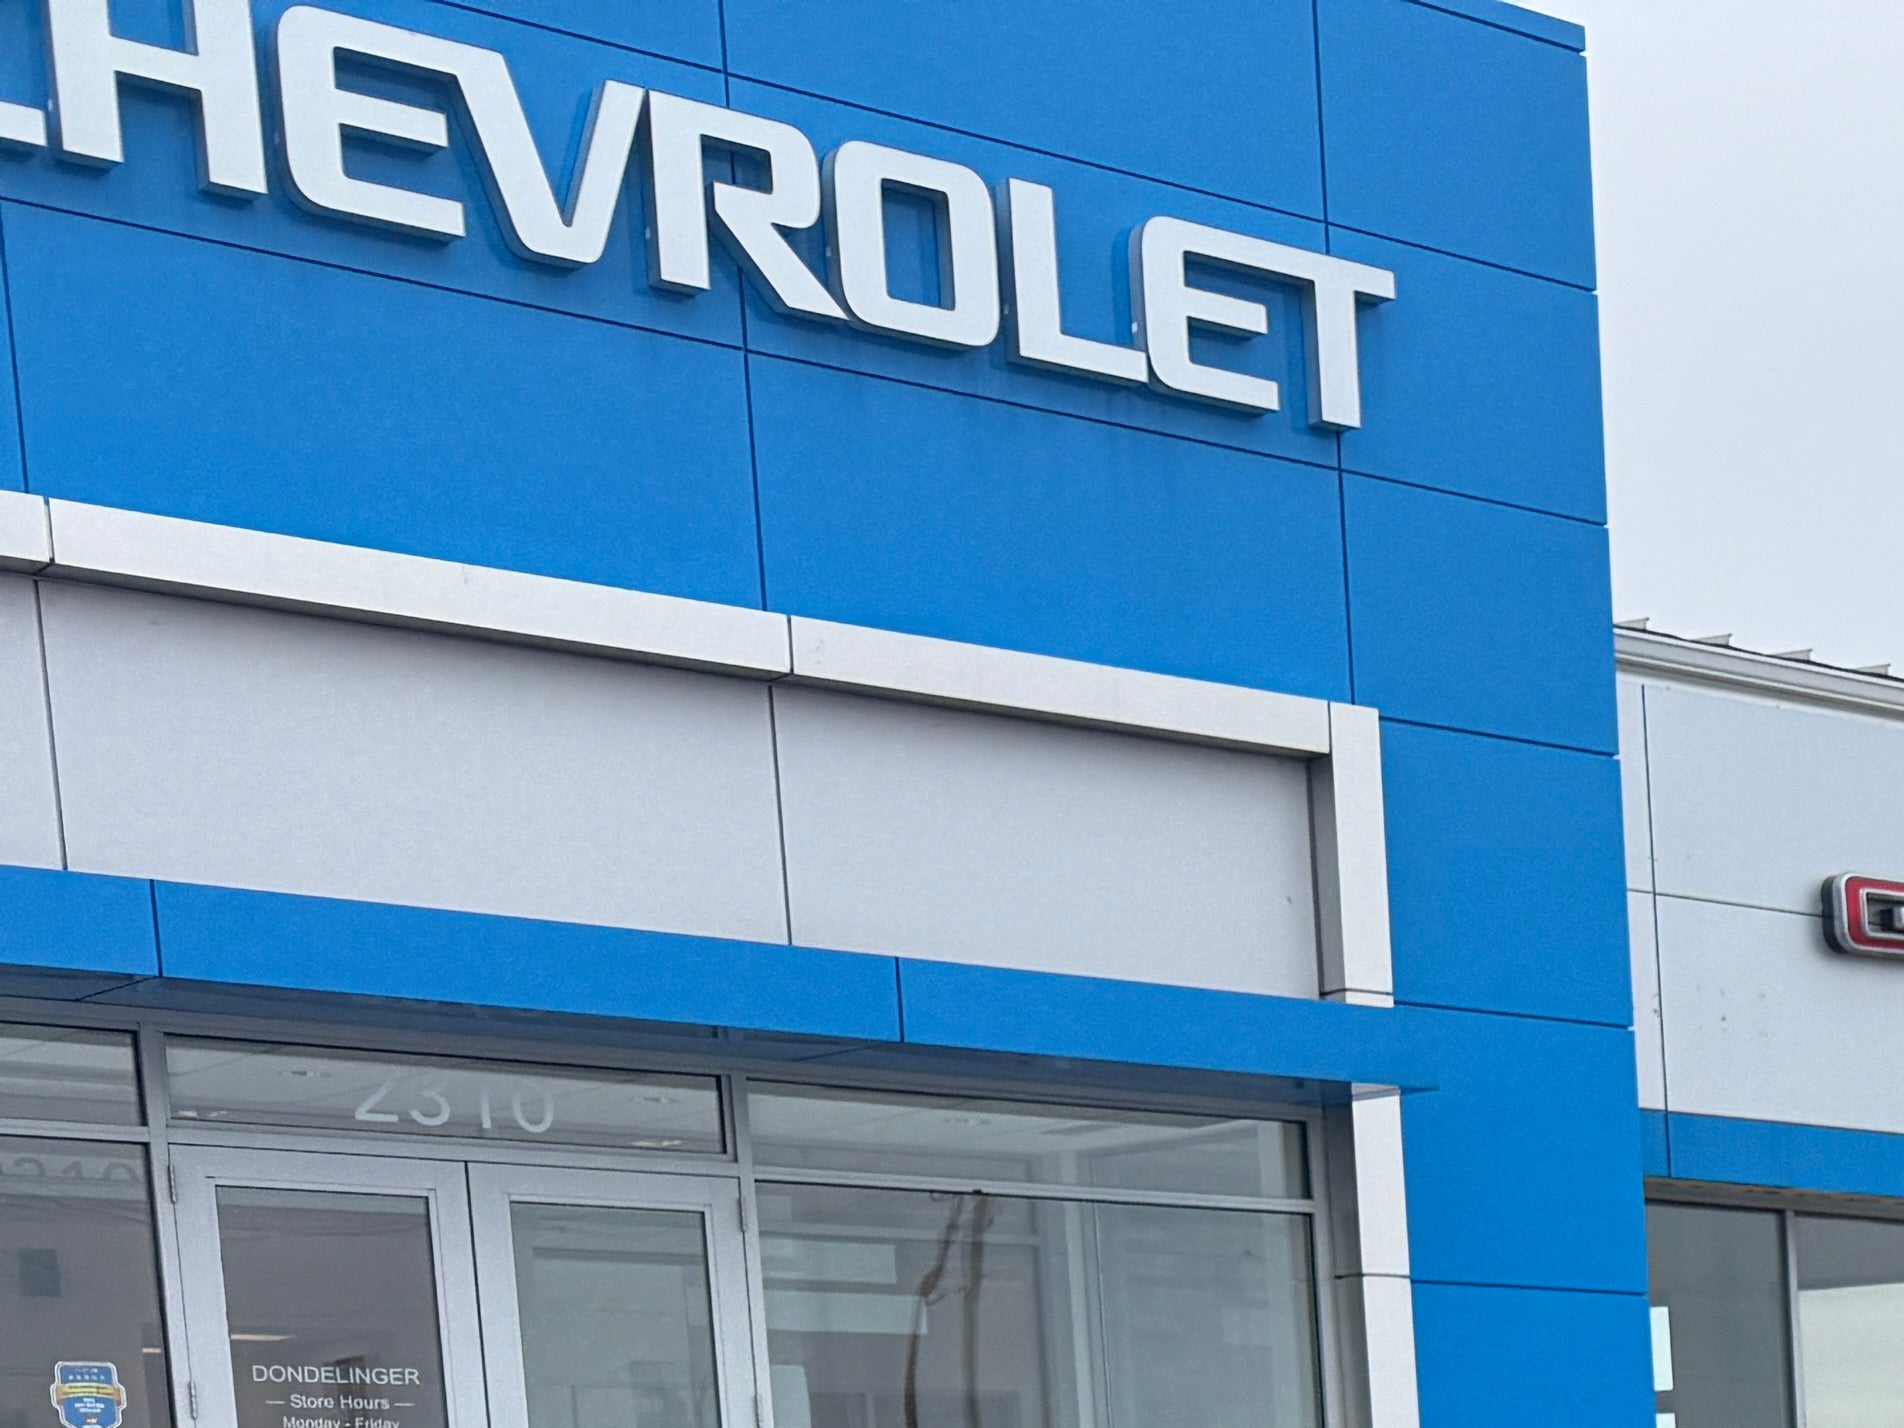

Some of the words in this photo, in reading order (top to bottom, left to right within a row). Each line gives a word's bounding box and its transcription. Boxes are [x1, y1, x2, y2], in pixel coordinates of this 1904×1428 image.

[0, 0, 1396, 431] HEVROLET
[252, 1364, 420, 1385] DONDELINGER
[290, 1393, 335, 1409] Store
[340, 1394, 390, 1410] Hours
